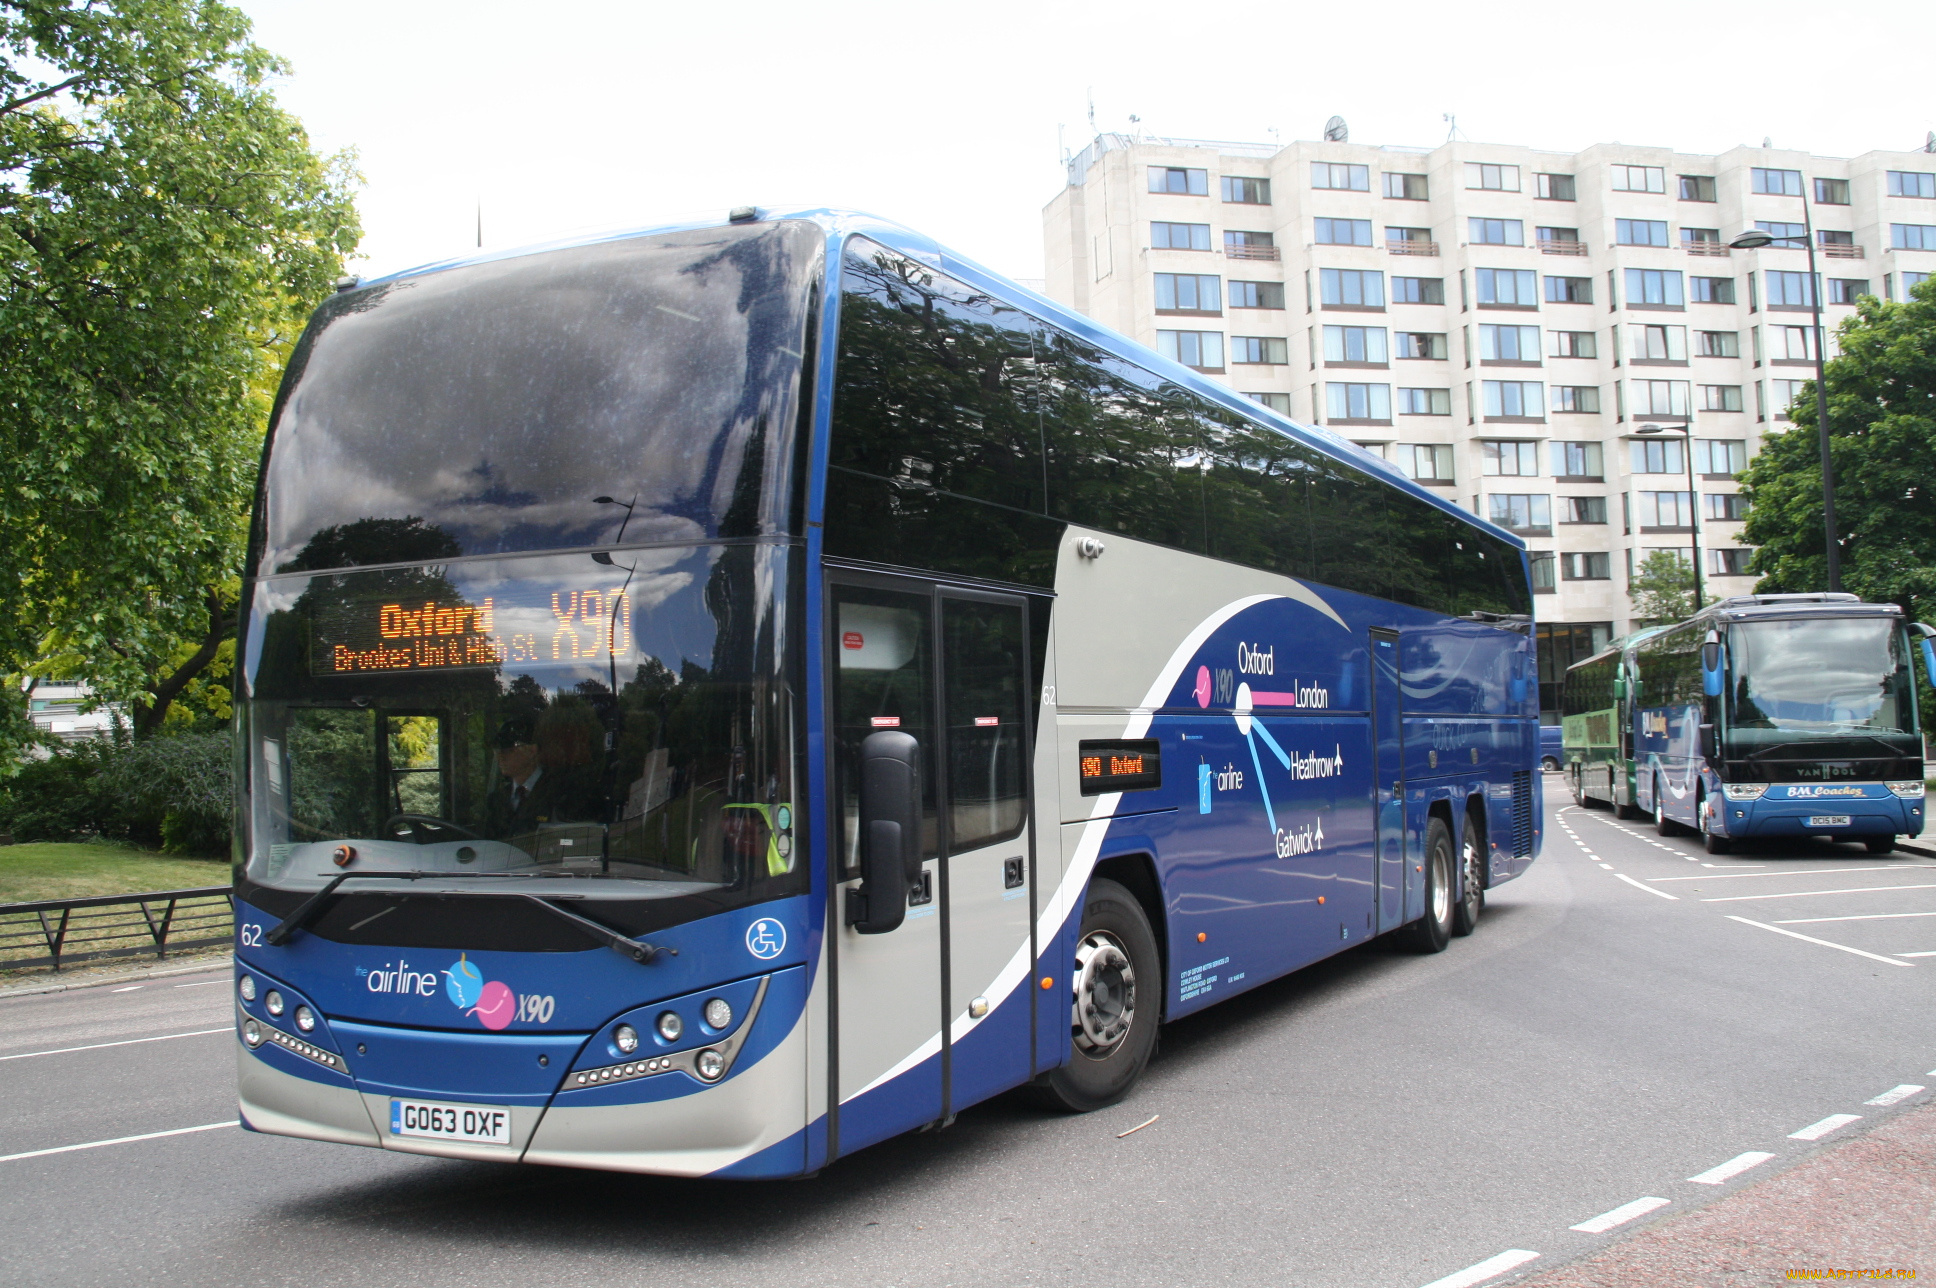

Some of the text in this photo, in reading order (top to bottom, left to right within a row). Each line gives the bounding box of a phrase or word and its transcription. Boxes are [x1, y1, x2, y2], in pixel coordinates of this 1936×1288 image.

[380, 598, 493, 638] Oxford
[552, 588, 630, 659] X90
[335, 633, 538, 671] Brookes Uni & High St
[1238, 641, 1273, 675] Oxford
[1042, 685, 1056, 706] 62
[1213, 667, 1234, 704] X90
[1294, 678, 1328, 709] London
[1111, 755, 1142, 775] Oxford
[1217, 762, 1243, 791] airline
[1290, 750, 1334, 780] Heathrow
[1787, 785, 1863, 798] BM Coaches
[1812, 816, 1830, 825] DC15
[1276, 823, 1314, 859] Gatwick
[241, 923, 262, 947] 62
[355, 959, 437, 997] the airline
[514, 994, 555, 1024] X90
[405, 1105, 457, 1133] GO63
[463, 1110, 505, 1137] OXF
